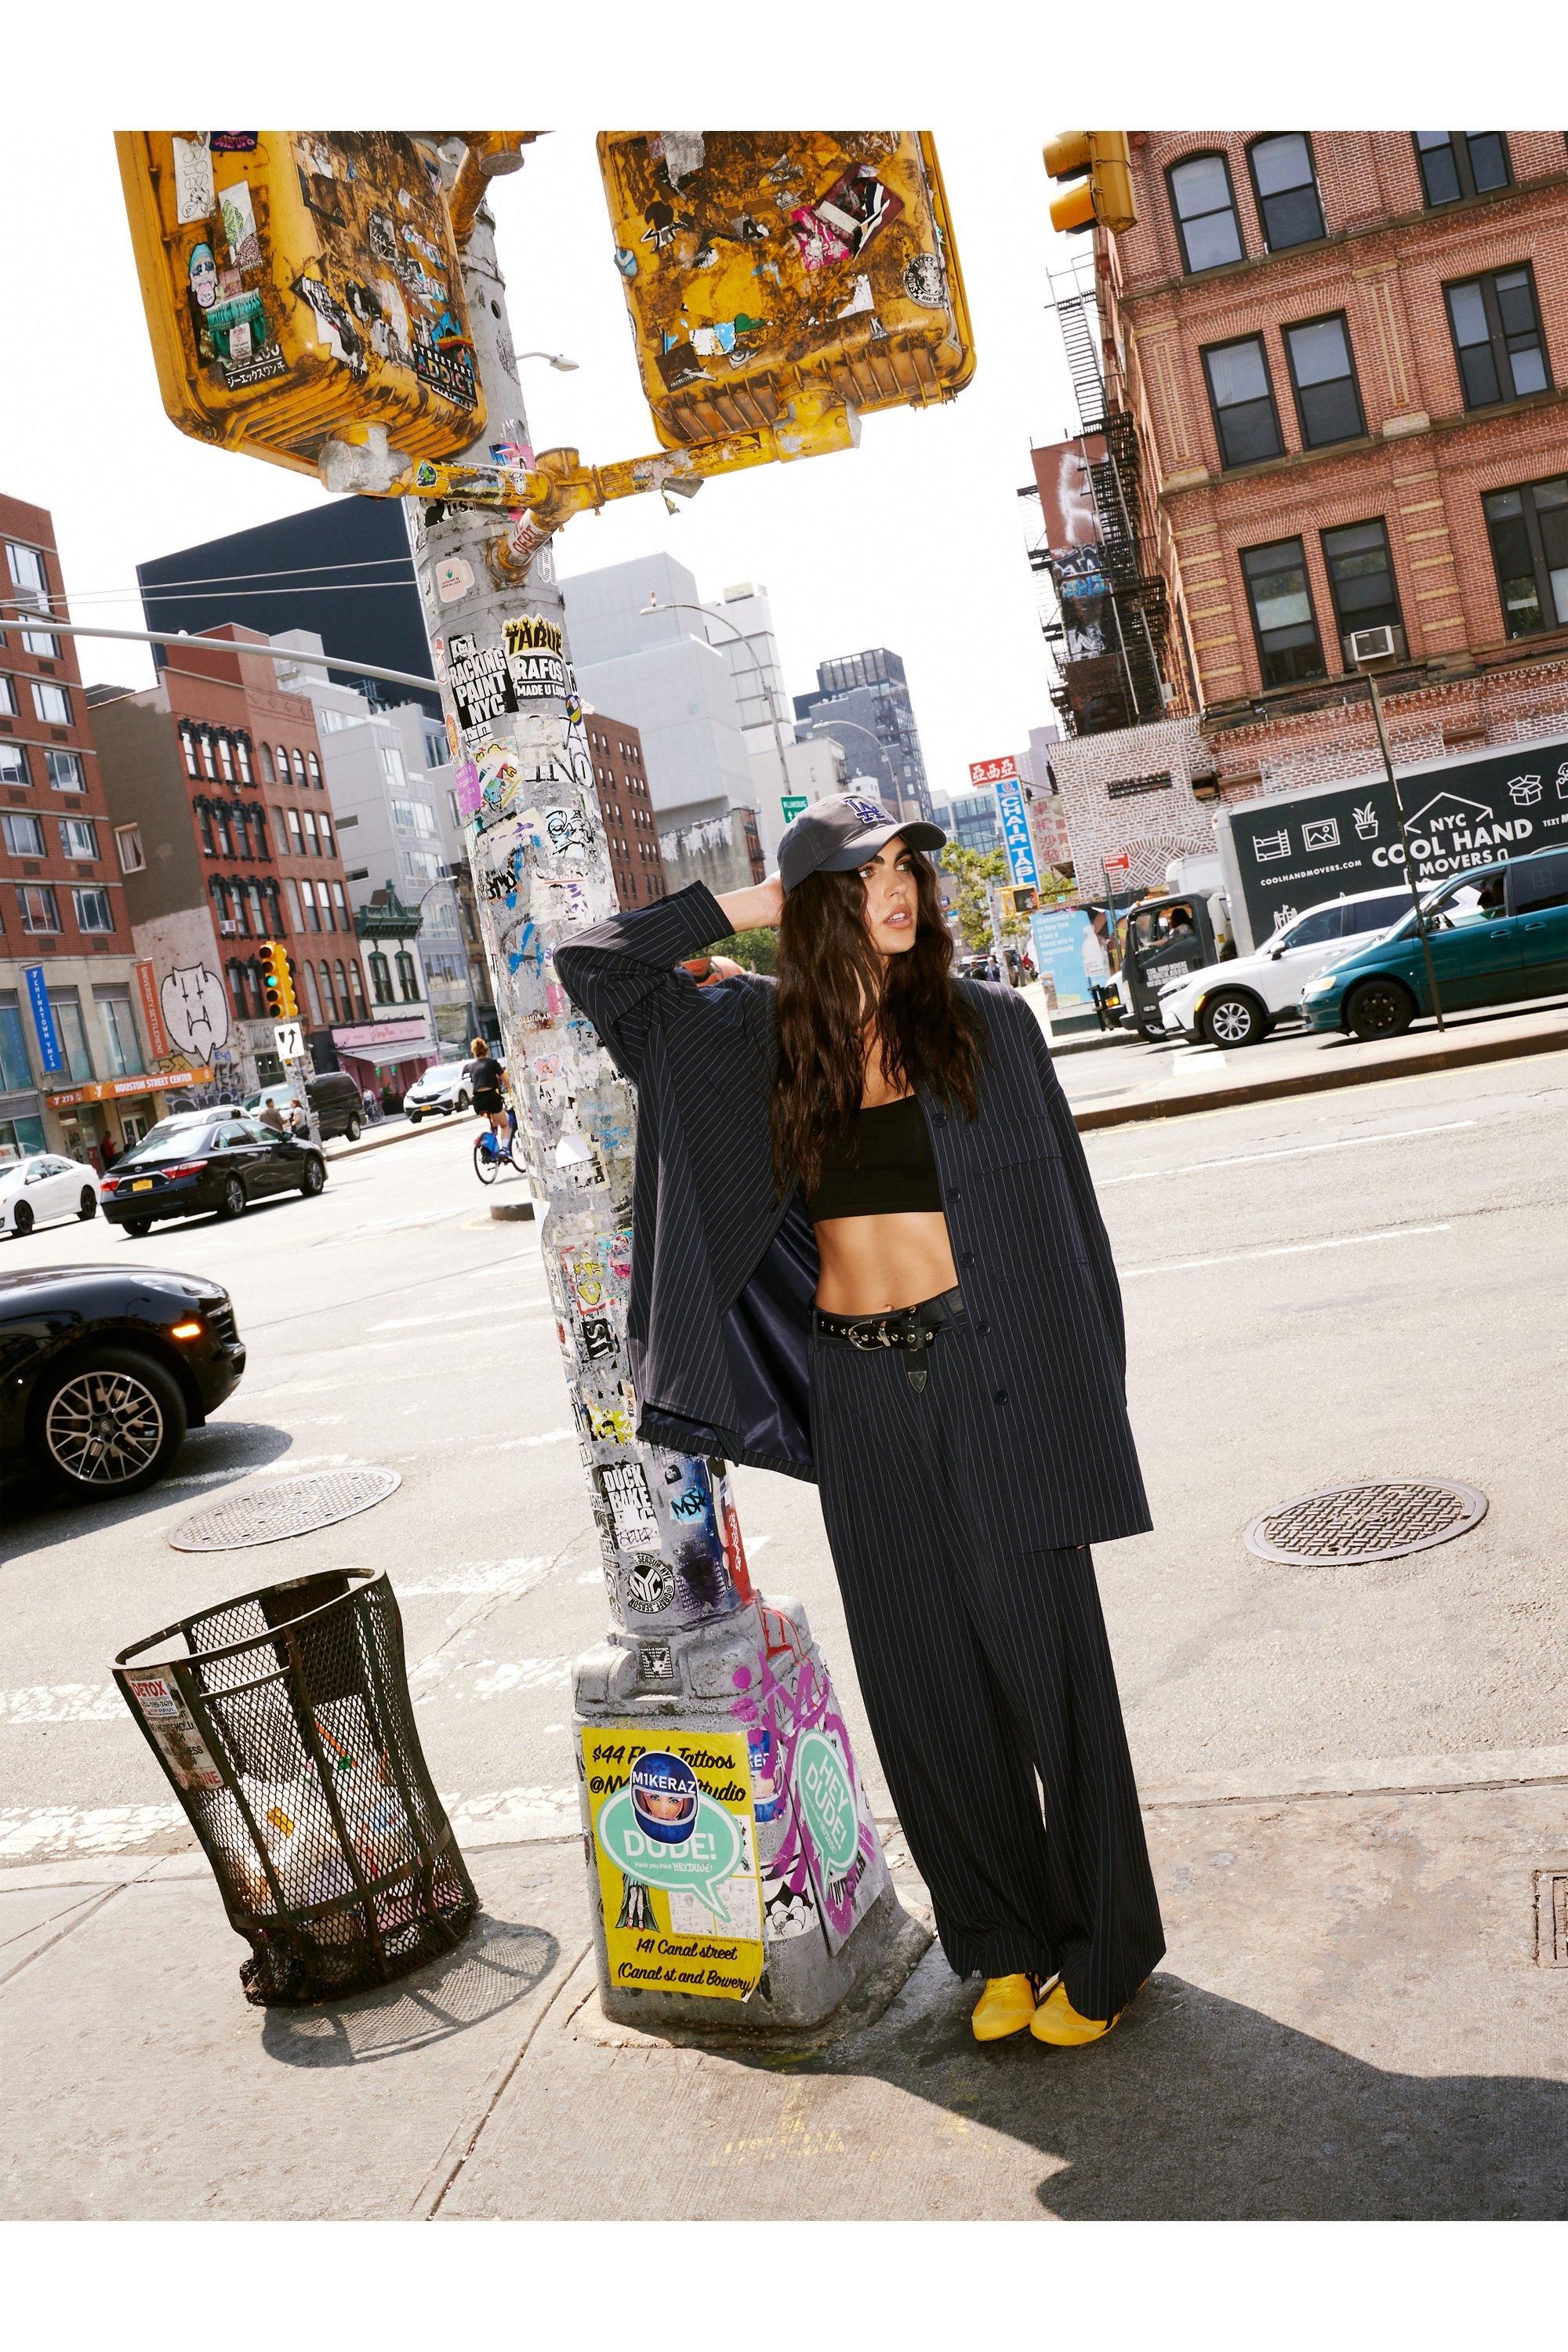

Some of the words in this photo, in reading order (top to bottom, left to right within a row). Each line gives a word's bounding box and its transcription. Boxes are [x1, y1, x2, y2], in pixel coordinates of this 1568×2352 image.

[412, 343, 471, 378] STREETART
[448, 648, 507, 688] RACKING
[518, 658, 564, 682] RAFOS
[455, 670, 506, 708] PAINT
[517, 684, 543, 696] MADE
[544, 684, 552, 695] U
[467, 693, 506, 726] NYC
[971, 758, 1017, 783] 亞西亞
[840, 797, 886, 824] LA
[1000, 796, 1029, 845] CHAIR
[1430, 813, 1467, 833] NYC
[1542, 818, 1559, 827] TEXT
[1372, 837, 1446, 868] COOL
[1453, 818, 1534, 851] HAND
[1260, 859, 1363, 886] COOLHANDMOVERS.COM
[1419, 848, 1494, 877] MOVERS
[140, 966, 154, 1008] UNIVERSITY
[148, 1006, 164, 1055] SETTLEMENT
[34, 980, 50, 1039] CHINATOWN
[45, 1040, 56, 1069] YMCA
[114, 1082, 146, 1094] HOUSTON
[147, 1078, 169, 1089] STREET
[169, 1073, 192, 1085] CENTER
[61, 1094, 74, 1104] 273
[602, 1465, 646, 1491] DUCK
[629, 1568, 662, 1602] NYC
[131, 1680, 168, 1697] DETOX
[592, 1744, 626, 1764] $44
[678, 1748, 736, 1769] Tattoos
[632, 1771, 697, 1795] M1KERAZ
[819, 1754, 850, 1813] HEY
[804, 1761, 848, 1852] DUDE!
[636, 1938, 655, 1954] 141
[657, 1939, 699, 1957] Canal
[699, 1944, 738, 1961] street
[618, 1962, 662, 1980] (Canal
[663, 1968, 677, 1982] st
[677, 1969, 705, 1984] and
[706, 1969, 756, 1998] Bowery)
